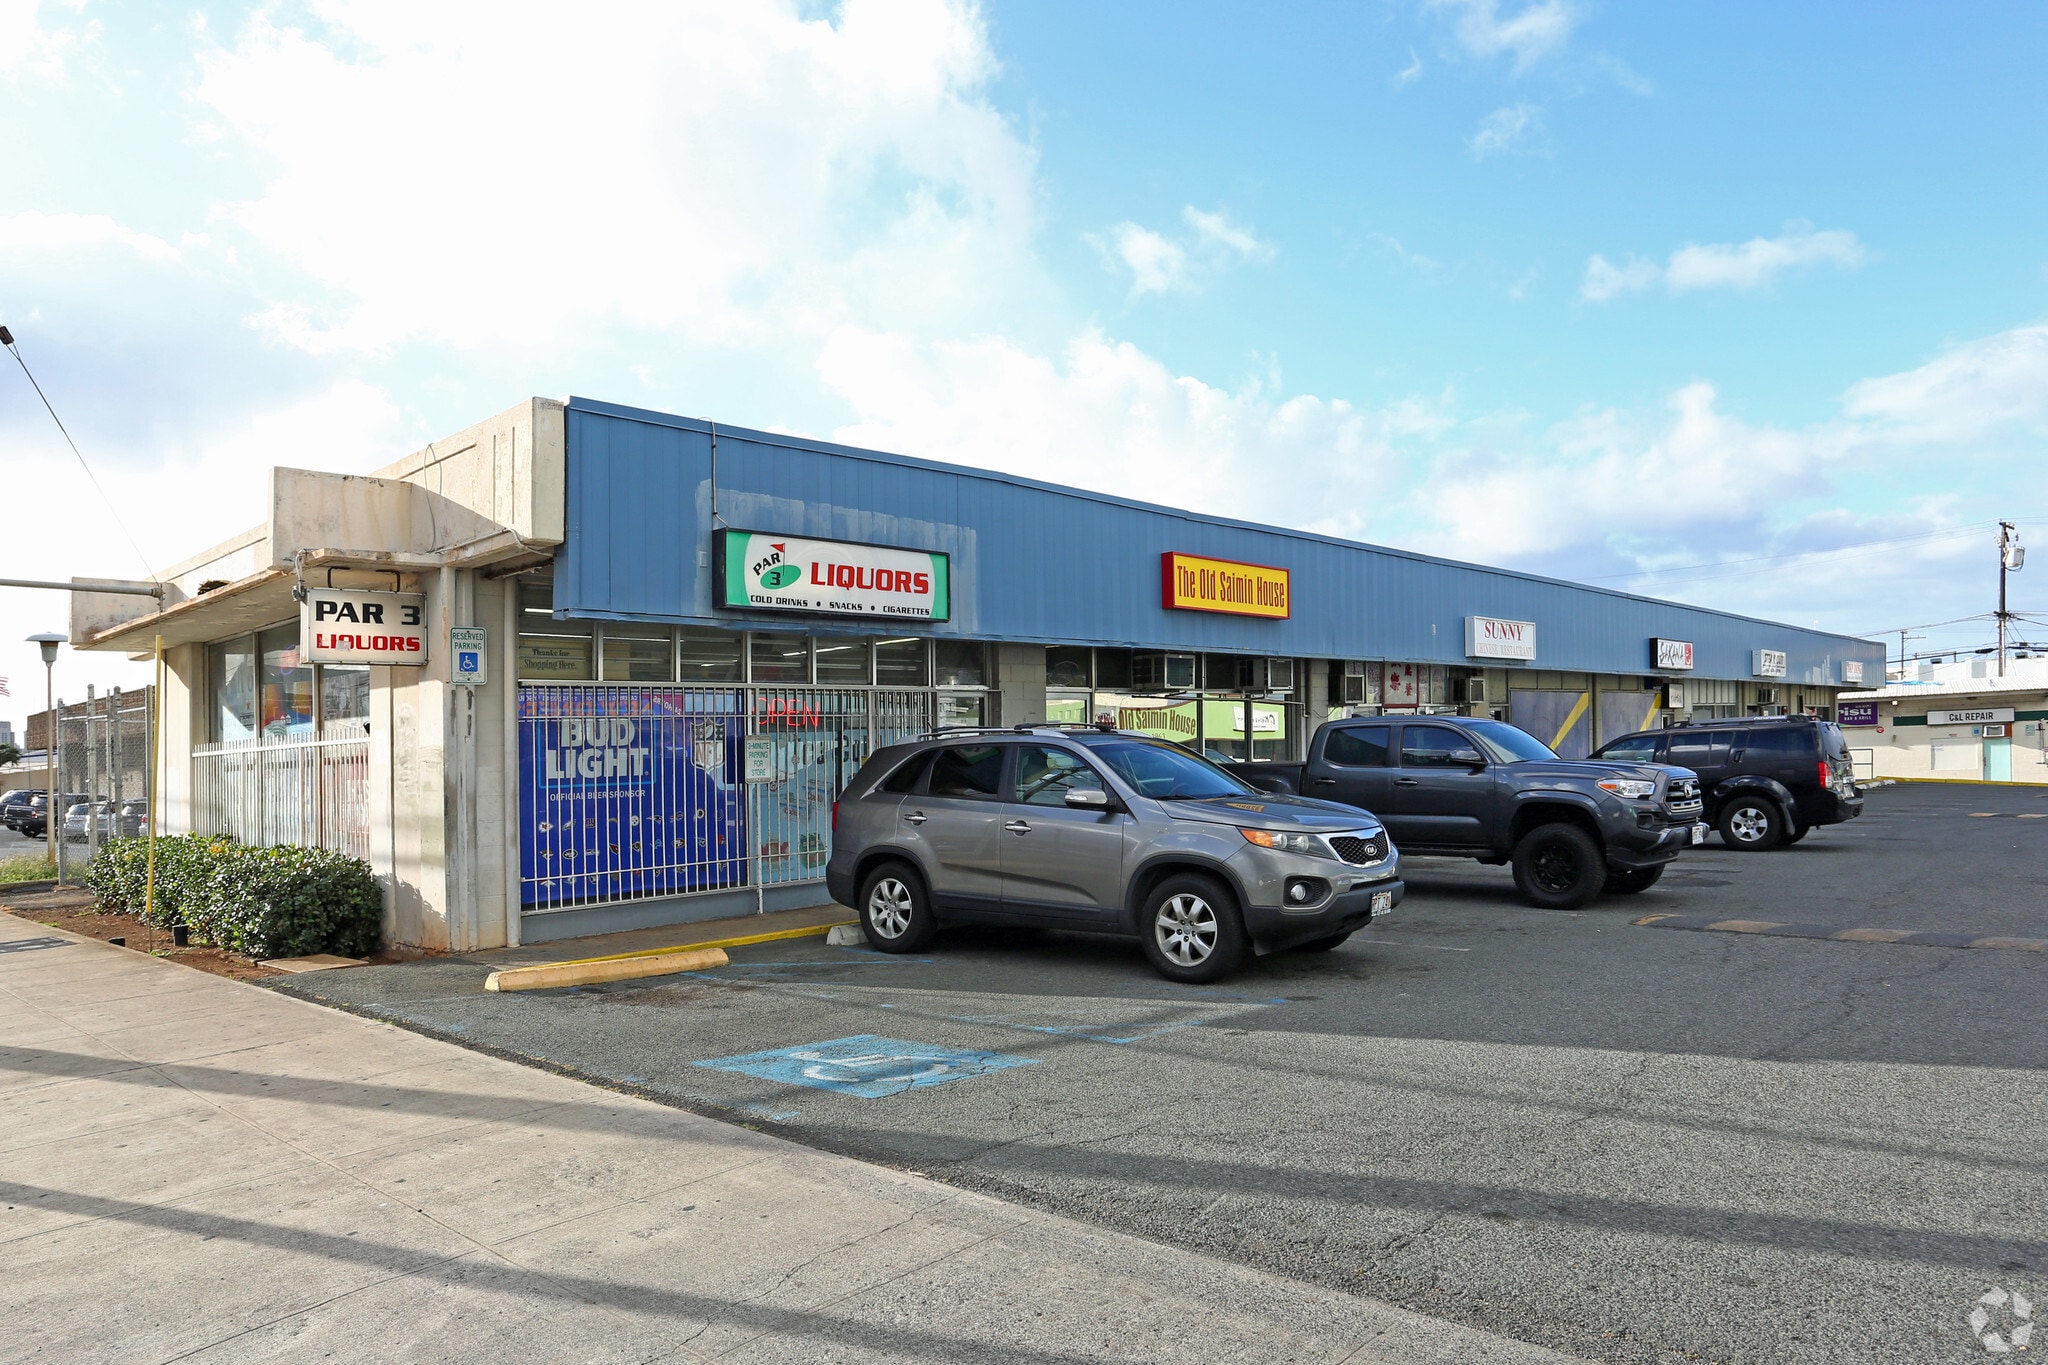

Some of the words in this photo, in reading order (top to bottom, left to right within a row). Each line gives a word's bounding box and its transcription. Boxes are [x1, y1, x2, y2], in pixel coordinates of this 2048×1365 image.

[753, 552, 781, 576] PAR
[769, 571, 781, 586] 3
[810, 562, 929, 595] LIQUORS
[1177, 565, 1196, 598] The
[1199, 568, 1217, 601] Old
[1219, 571, 1254, 605] Saimin
[1256, 576, 1285, 608] House
[315, 600, 384, 624] PAR
[401, 605, 421, 626] 3
[750, 594, 773, 604] COLD
[775, 596, 808, 608] DRINKS
[829, 601, 863, 611] SNACKS
[882, 605, 930, 616] CIGARETTES
[453, 632, 484, 641] RESERVED
[1484, 621, 1524, 642] SUNNY
[454, 642, 482, 650] PARKING
[524, 659, 558, 671] Shopping
[558, 660, 577, 670] Here.
[752, 697, 820, 728] OPEN
[1119, 709, 1134, 730] Old
[1136, 708, 1168, 731] Saimin
[1169, 709, 1196, 736] House
[1949, 713, 1964, 721] C&L
[1965, 712, 1994, 721] REPAIR
[561, 718, 636, 748] BUD
[546, 747, 649, 779] LIGHT
[748, 751, 768, 759] PARKING
[753, 760, 764, 768] FOR
[751, 768, 767, 777] STORE
[550, 791, 585, 801] OFFICIAL
[588, 790, 608, 800] BEER
[609, 789, 646, 799] SPONSOR
